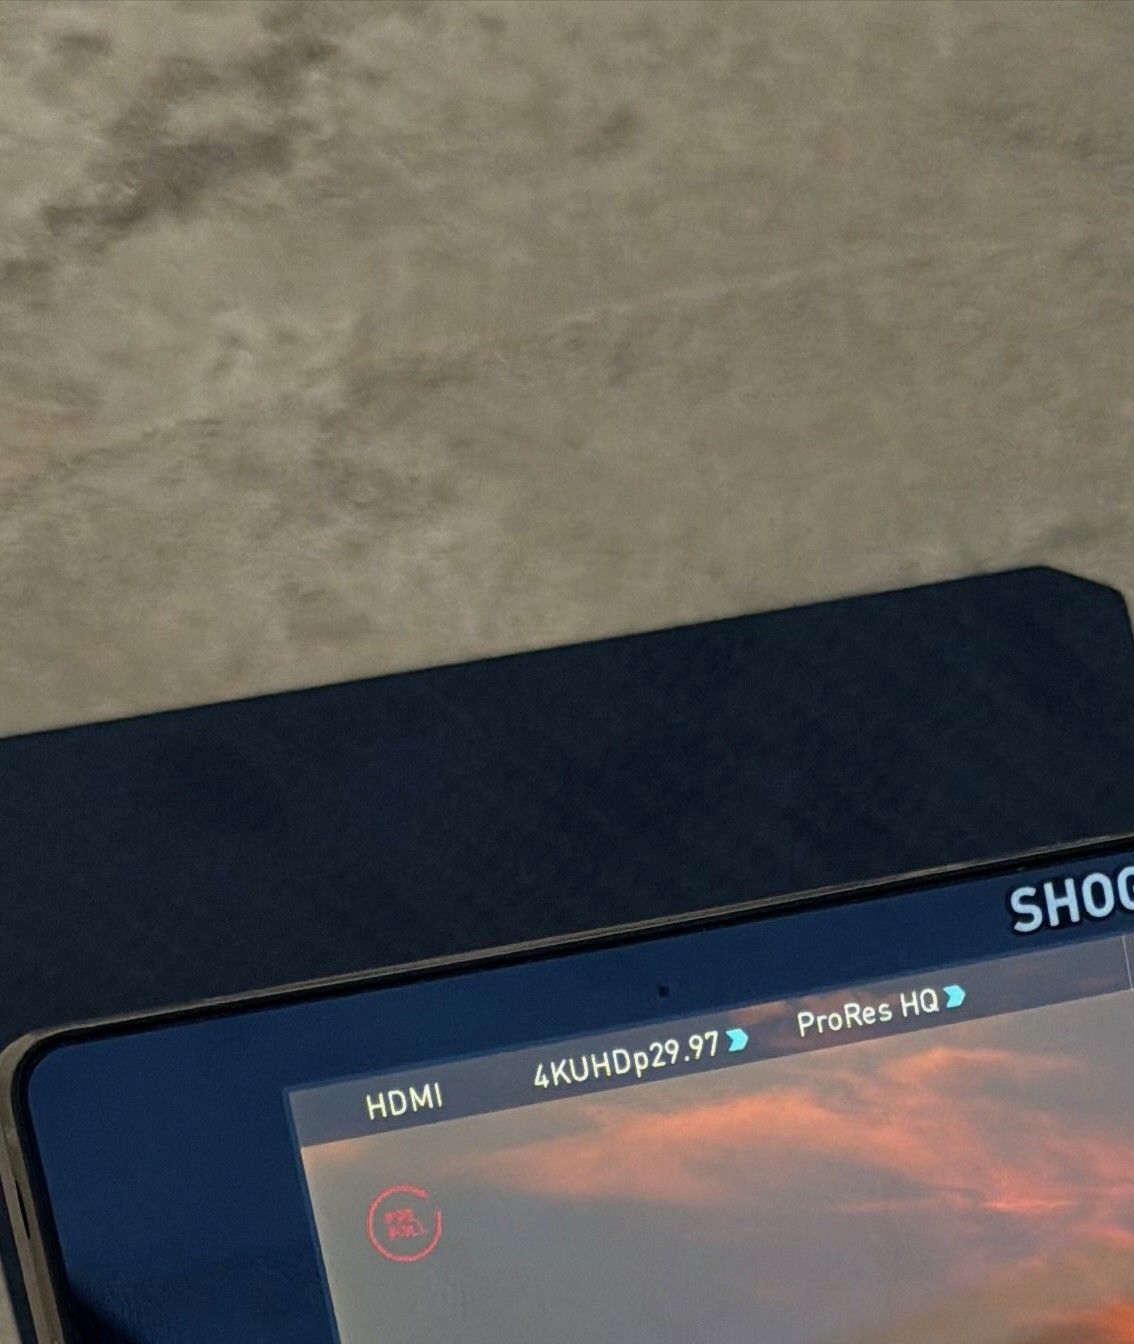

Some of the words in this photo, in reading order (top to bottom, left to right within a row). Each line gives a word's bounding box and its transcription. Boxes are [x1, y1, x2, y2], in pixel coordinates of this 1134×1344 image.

[798, 1001, 893, 1037] ProRes
[900, 987, 939, 1017] HQ
[533, 1031, 720, 1089] 4KUHDp29.97
[367, 1082, 442, 1120] HDMI
